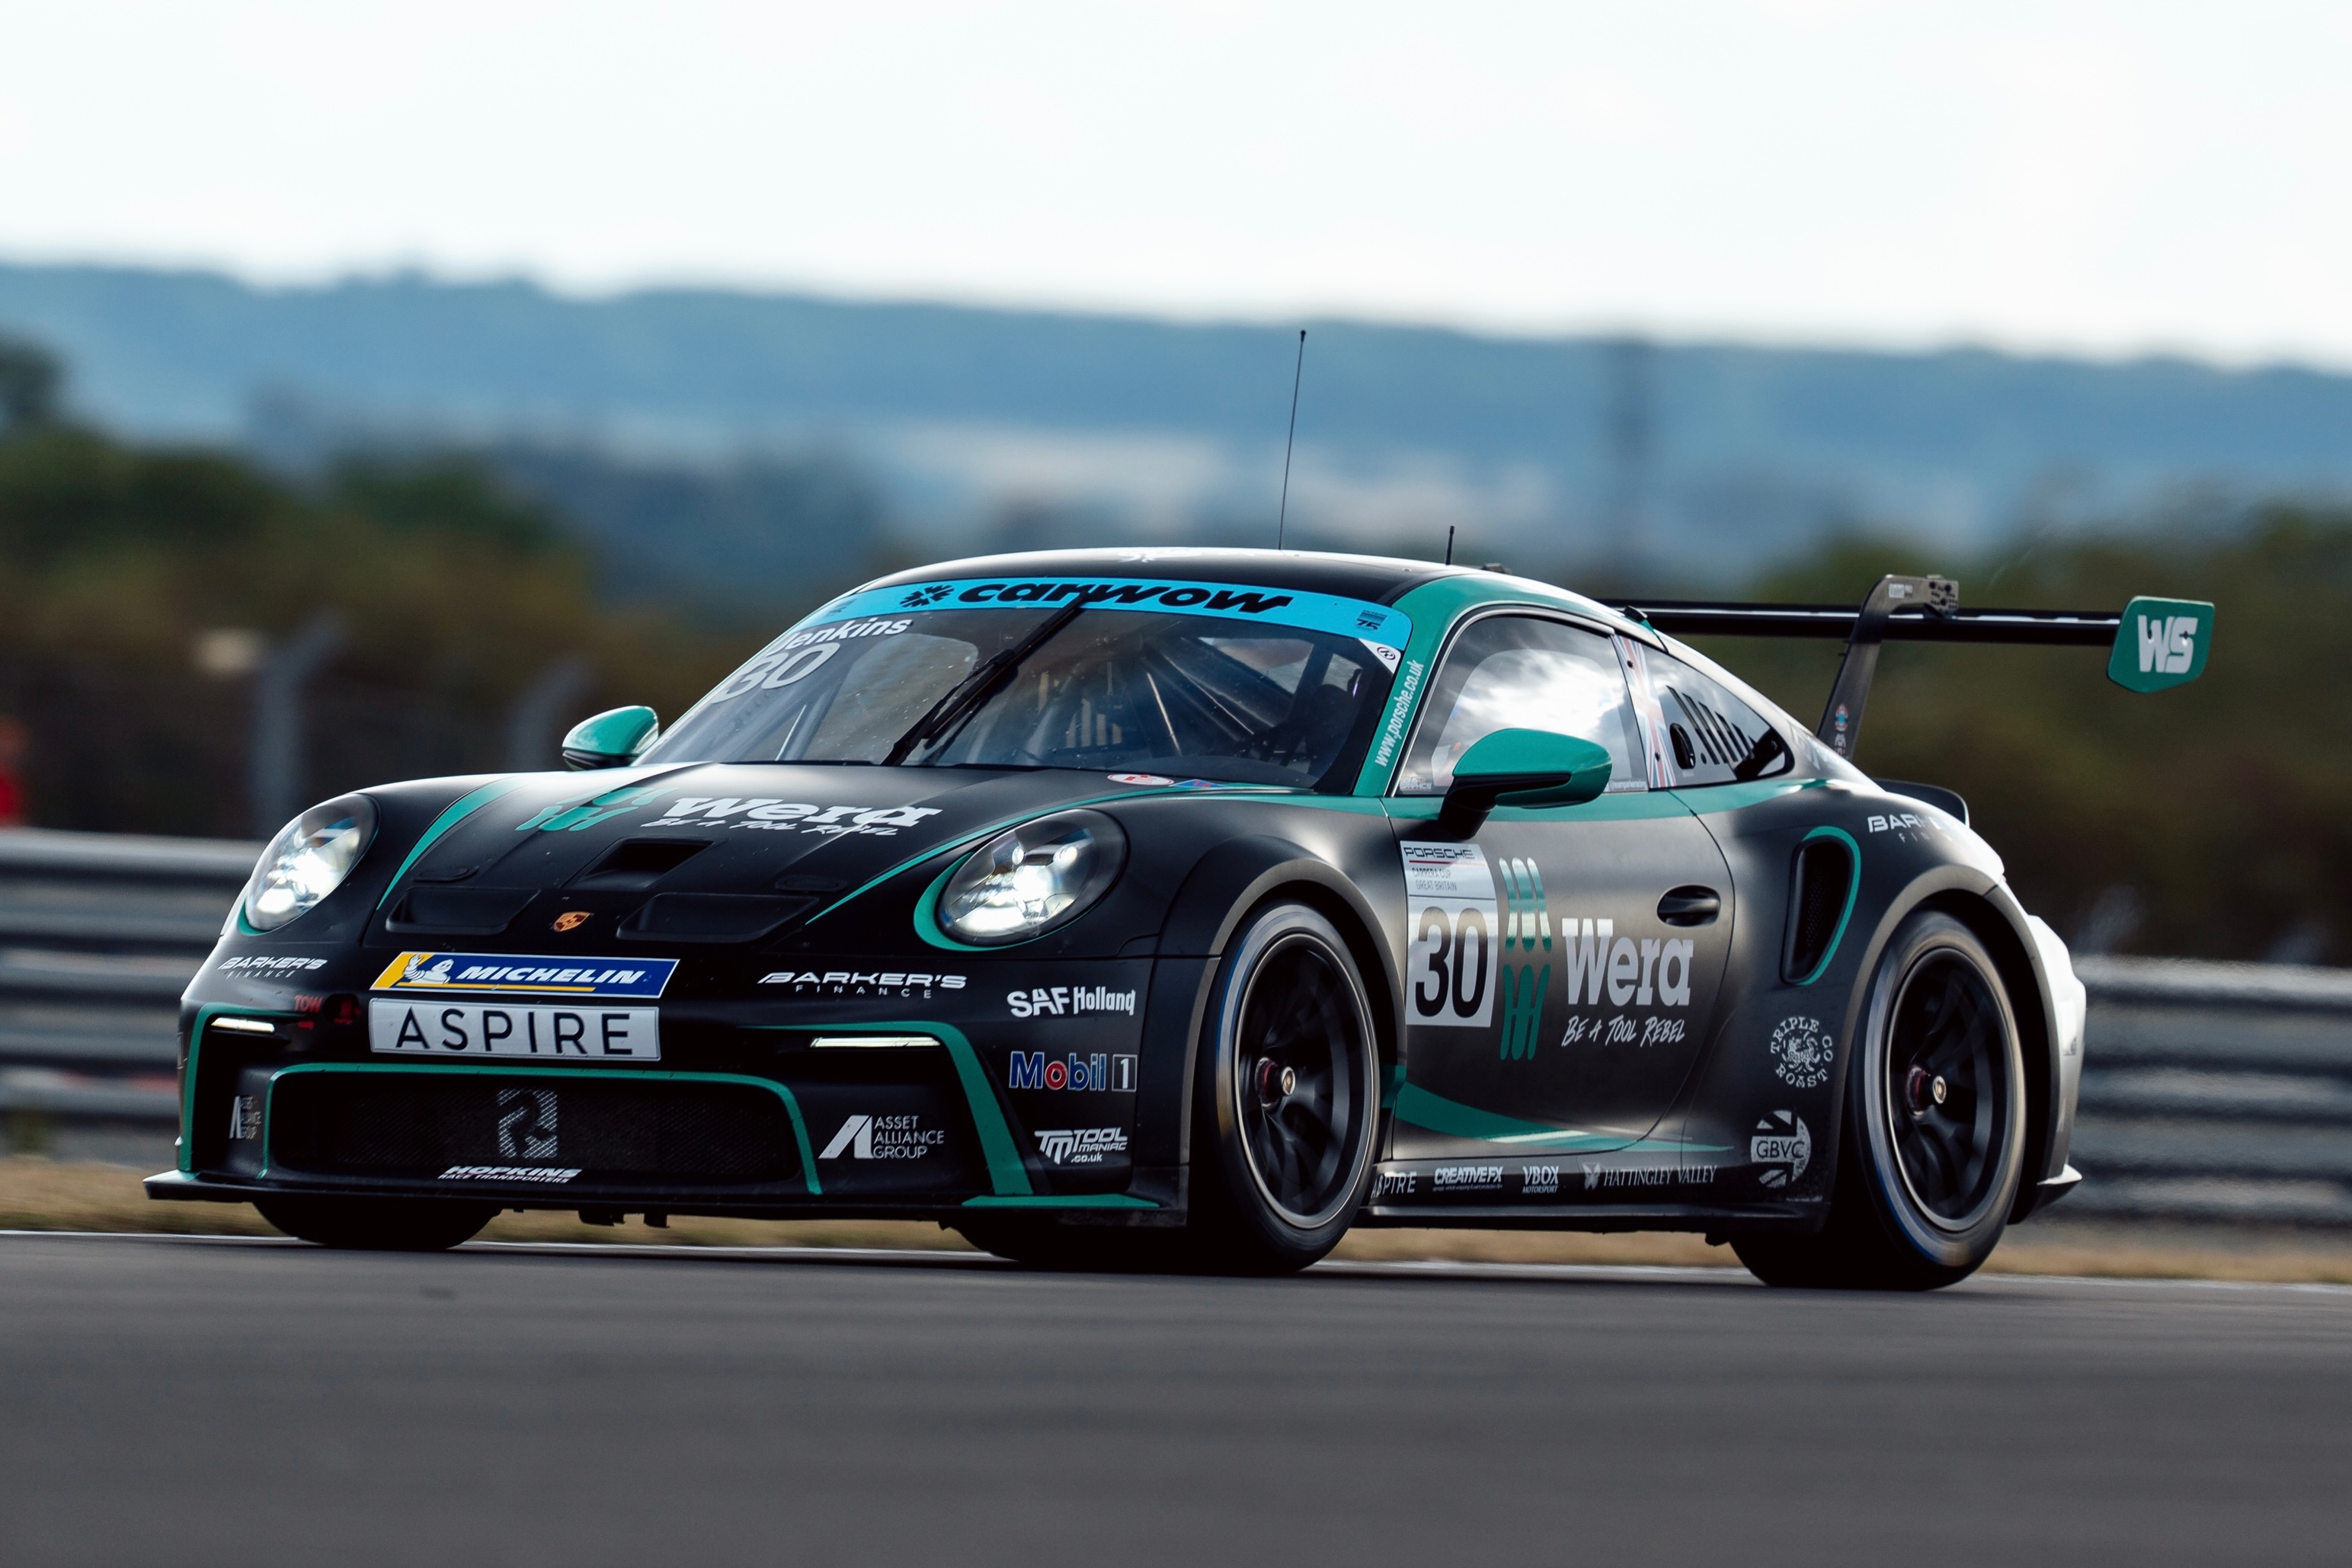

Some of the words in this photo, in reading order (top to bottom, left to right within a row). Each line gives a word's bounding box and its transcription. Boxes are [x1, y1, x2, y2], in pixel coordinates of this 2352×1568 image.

[958, 582, 1294, 614] carwow
[764, 617, 913, 658] Jenkins
[2138, 615, 2198, 674] WS
[710, 642, 841, 704] 30
[1374, 659, 1425, 768] www.porsche.co.uk
[662, 797, 944, 827] Wera
[729, 820, 798, 831] TOOL
[1403, 846, 1475, 860] PORSCHE
[1412, 867, 1438, 879] CARRERA
[1439, 869, 1452, 879] CUP
[1416, 880, 1434, 890] GREAT
[1435, 881, 1458, 891] BRITAIN
[217, 956, 328, 970] BARKER'S
[1415, 906, 1489, 1018] 30
[1562, 918, 1694, 1006] Wera
[456, 965, 646, 984] MICHELIN
[757, 971, 968, 989] BARKER'S
[795, 984, 933, 999] FINANCE
[293, 994, 324, 1013] TOW
[1006, 987, 1070, 1018] SAF
[1073, 986, 1136, 1016] Holland
[395, 1006, 634, 1055] ASPIRE
[1561, 1015, 1590, 1048] BE
[1589, 1018, 1603, 1043] A
[1605, 1014, 1637, 1046] TOOL
[1640, 1016, 1685, 1048] REBEL
[1770, 1016, 1820, 1054] TRIPLE
[1009, 1050, 1108, 1092] Mobil
[1775, 1062, 1829, 1089] ROAST
[874, 1115, 920, 1130] ASSET
[873, 1130, 945, 1144] ALLIANCE
[1072, 1128, 1128, 1153] TOOL
[872, 1145, 928, 1159] GROUP
[1078, 1142, 1128, 1153] MANIAC
[1756, 1140, 1805, 1158] GBVC
[1070, 1152, 1103, 1163] .co.uk
[444, 1166, 583, 1178] HOPKINS
[1522, 1166, 1560, 1185] VBOX
[1604, 1166, 1674, 1186] HATTINGLEY
[1675, 1165, 1717, 1184] VALLEY
[1371, 1171, 1417, 1198] ASPIRE
[1522, 1184, 1560, 1194] MOTORSPORT
